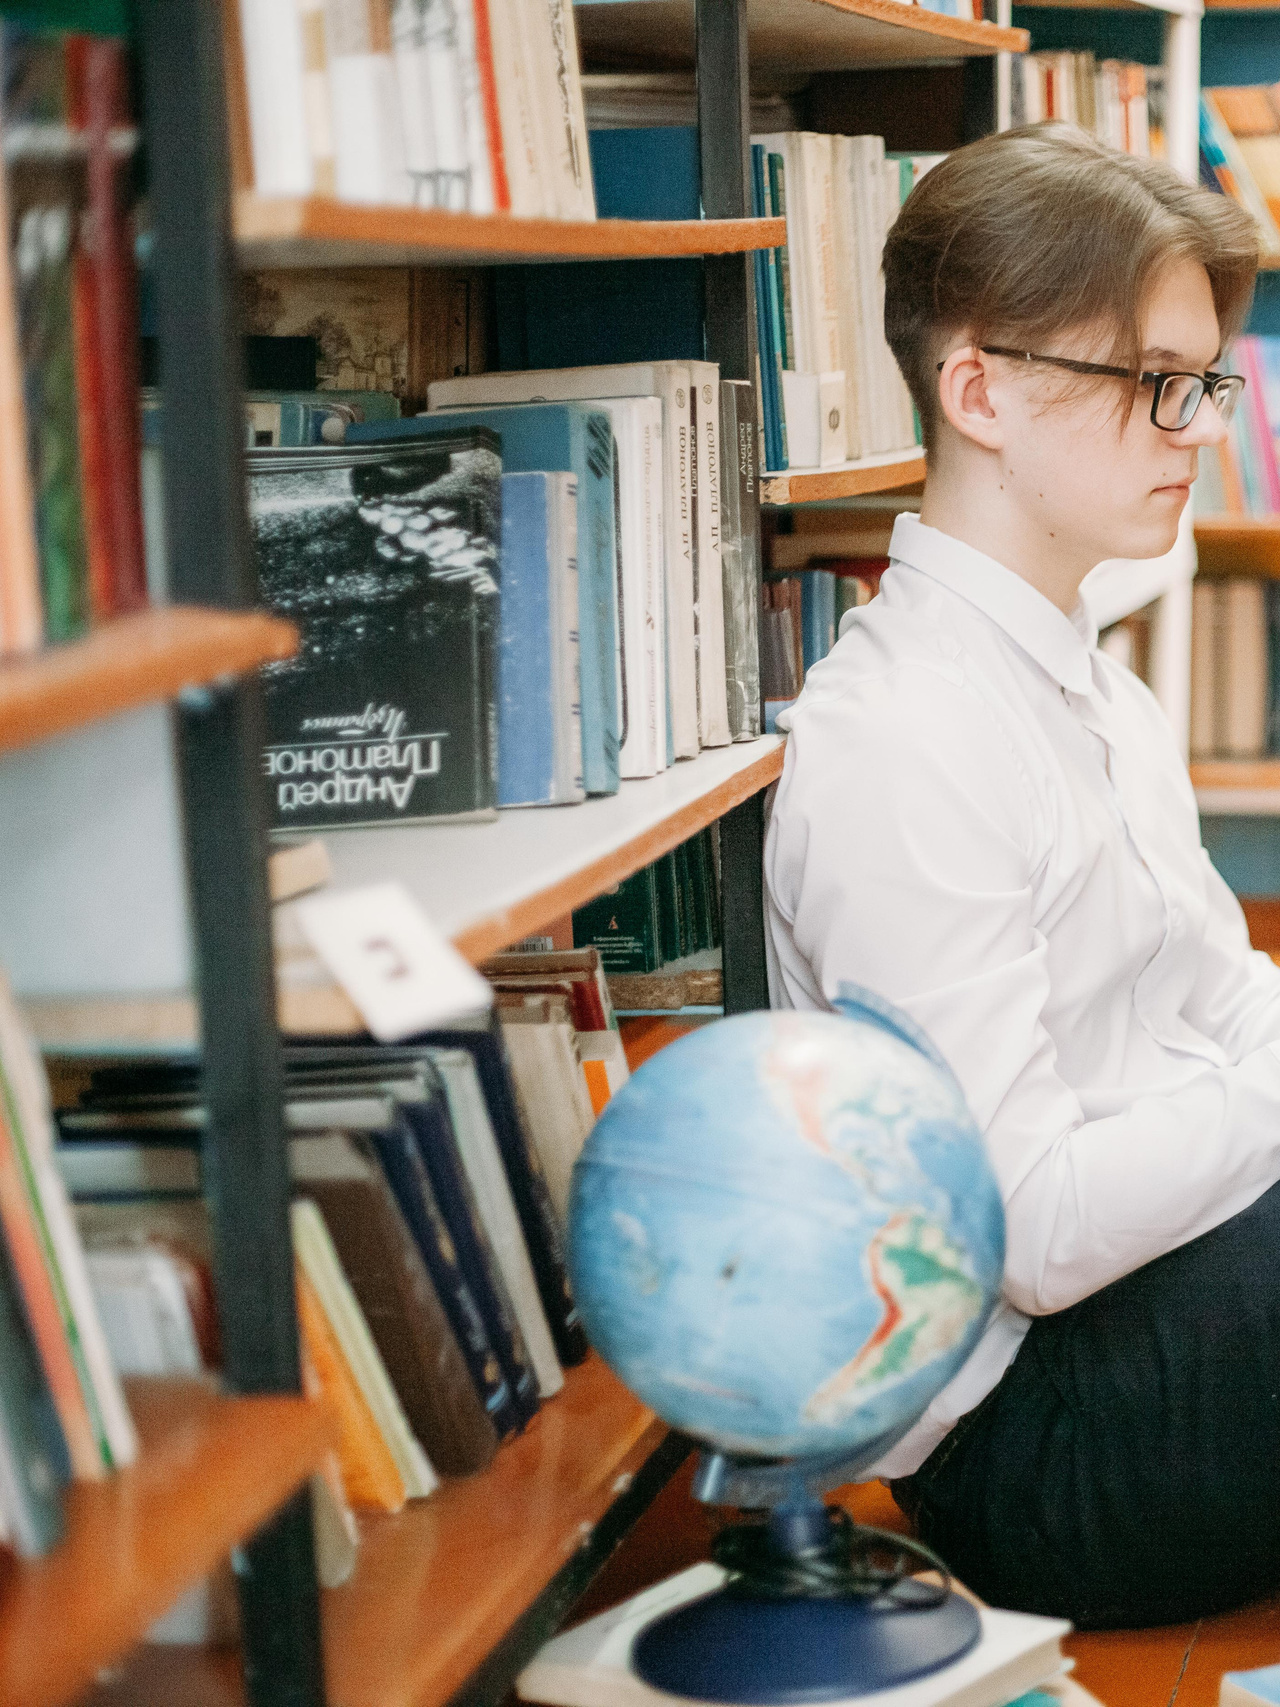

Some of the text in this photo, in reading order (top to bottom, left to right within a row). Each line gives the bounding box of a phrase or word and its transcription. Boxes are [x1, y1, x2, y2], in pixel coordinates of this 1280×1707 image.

[679, 425, 688, 520] ПЛАТОНОВ
[706, 421, 719, 513] ПЛАТОНОВ
[276, 771, 415, 811] Андрей
